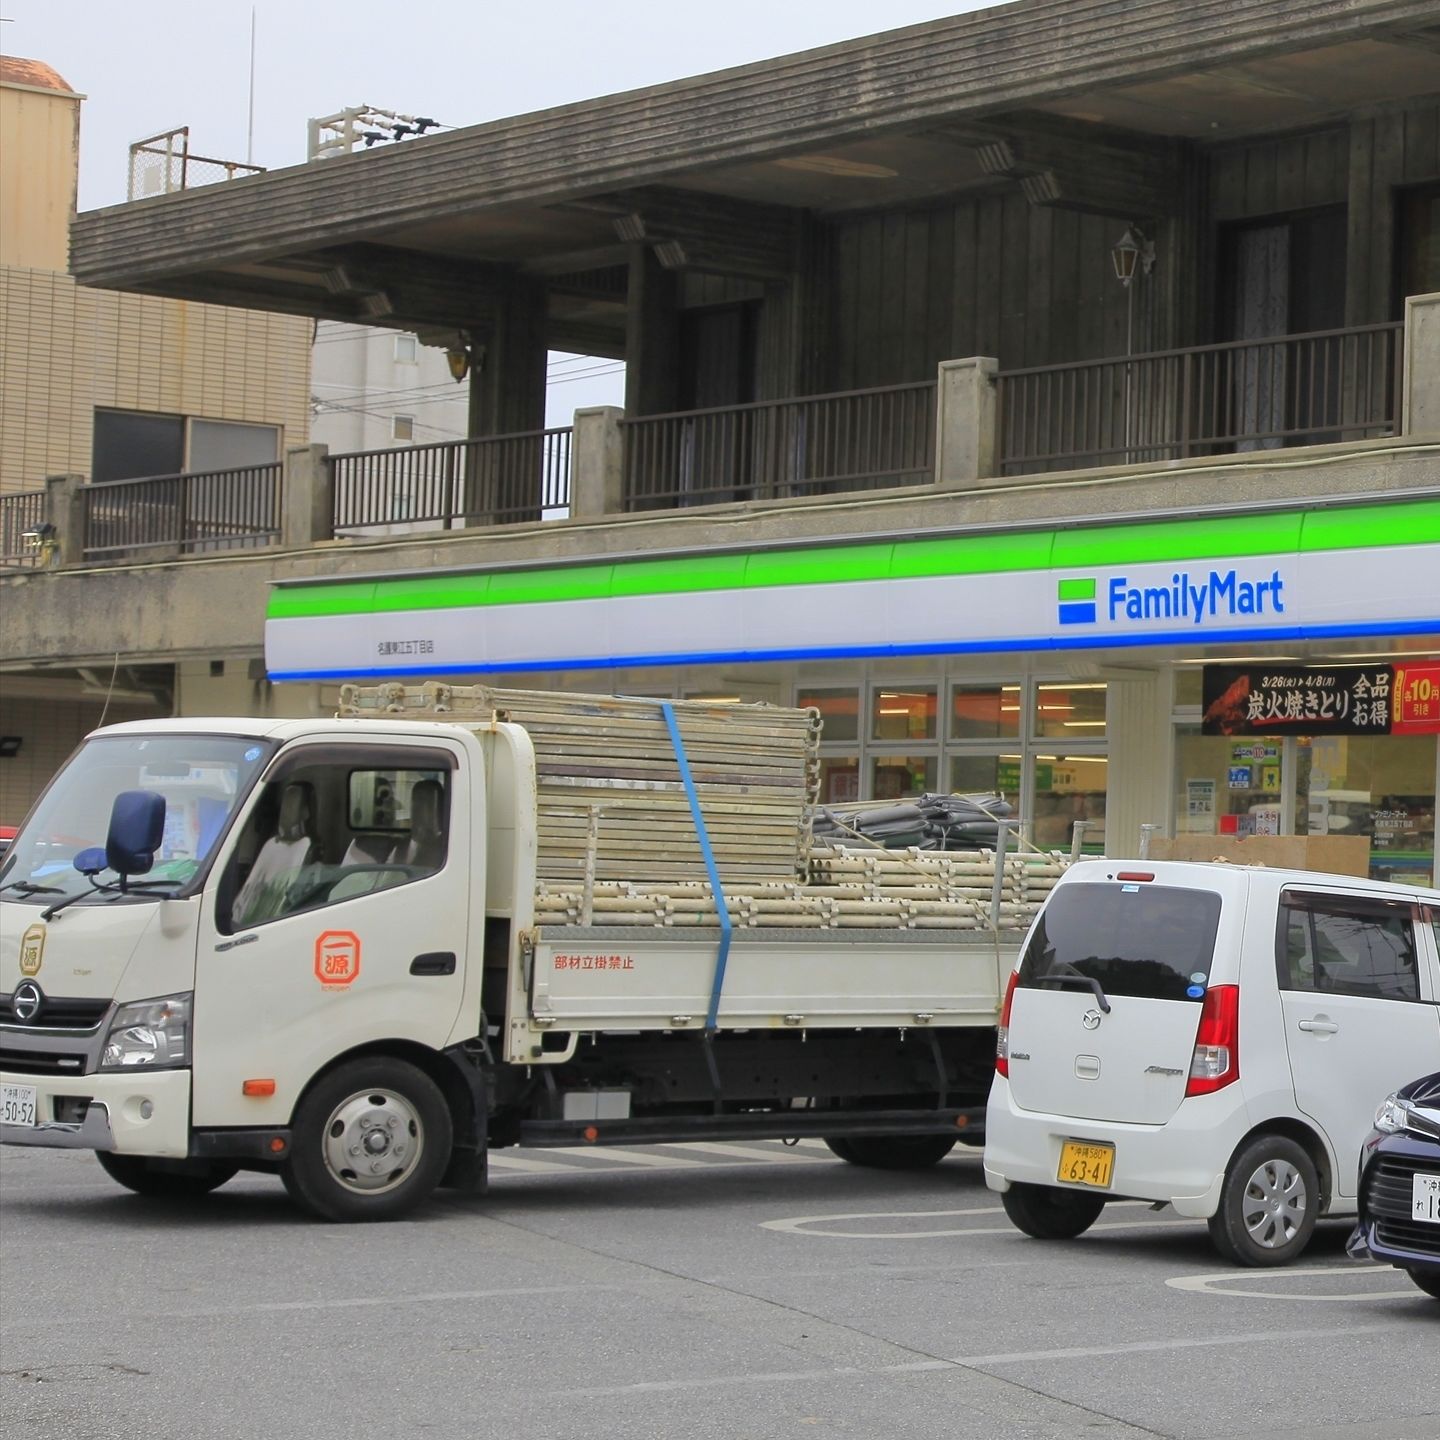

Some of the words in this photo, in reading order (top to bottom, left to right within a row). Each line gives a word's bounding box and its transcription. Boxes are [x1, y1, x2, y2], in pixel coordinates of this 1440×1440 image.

[1109, 570, 1284, 623] FamilyMart
[1353, 673, 1389, 698] 全品
[1246, 689, 1348, 720] 炭火焼きとり
[1352, 701, 1388, 726] お得
[1412, 704, 1429, 716] 引き
[323, 942, 353, 974] 一源
[554, 955, 634, 969] 部材立掛禁止
[1070, 1160, 1107, 1183] 63-41
